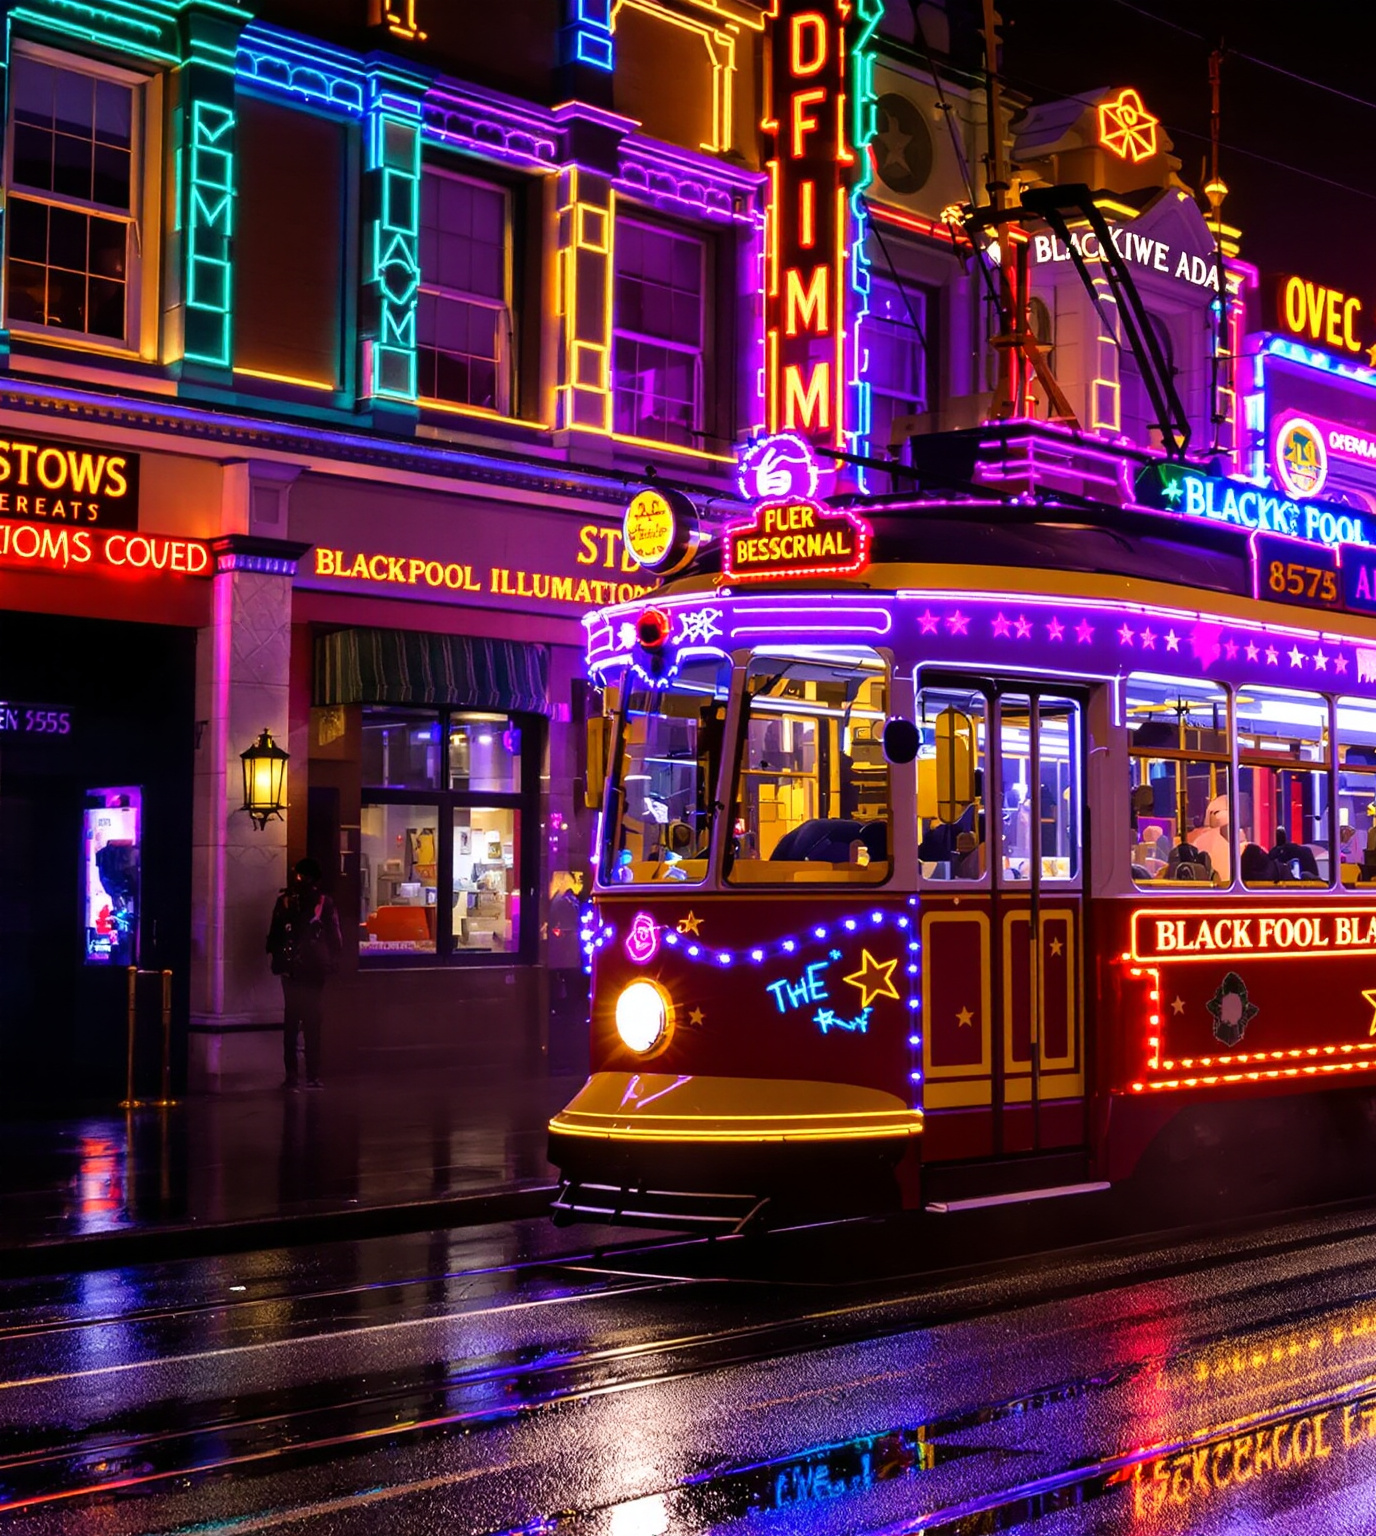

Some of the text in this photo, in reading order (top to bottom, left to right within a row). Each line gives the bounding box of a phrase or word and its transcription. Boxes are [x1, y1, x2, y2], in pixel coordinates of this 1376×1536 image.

[1284, 275, 1362, 353] OVEC
[1303, 504, 1370, 547] POOL
[104, 535, 208, 572] COUED
[314, 547, 482, 592] BLACKPOOL
[1155, 919, 1254, 951] BLACK
[765, 961, 829, 1014] THE
